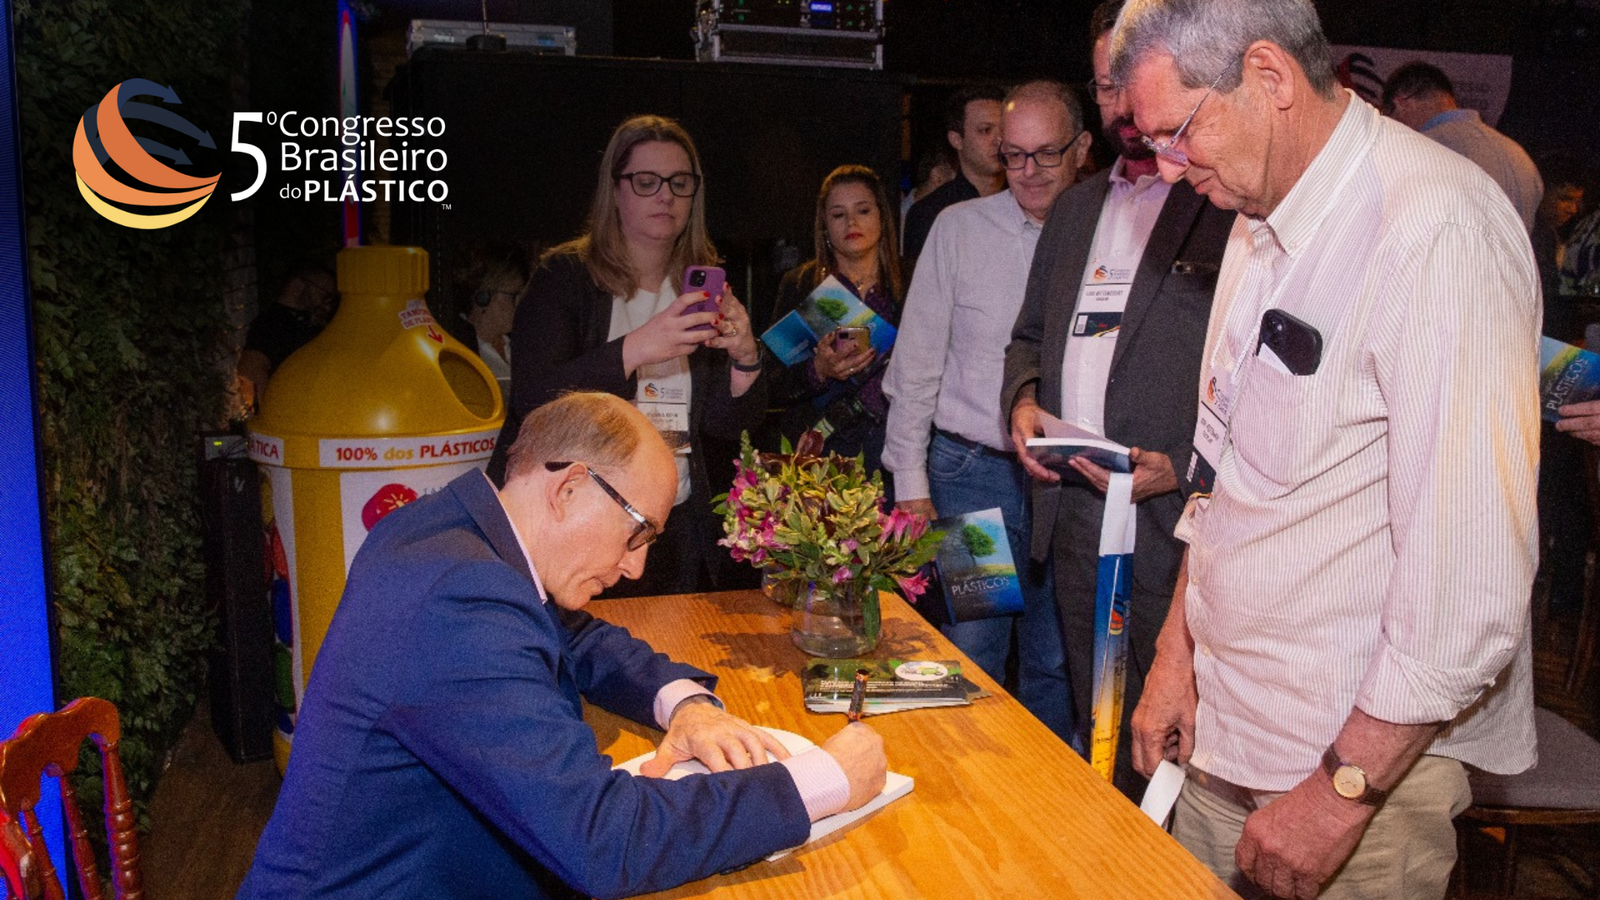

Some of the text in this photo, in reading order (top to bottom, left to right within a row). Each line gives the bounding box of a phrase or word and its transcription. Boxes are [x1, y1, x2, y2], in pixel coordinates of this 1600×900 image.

[336, 438, 495, 461] 100% dos PLÁSTICOS
